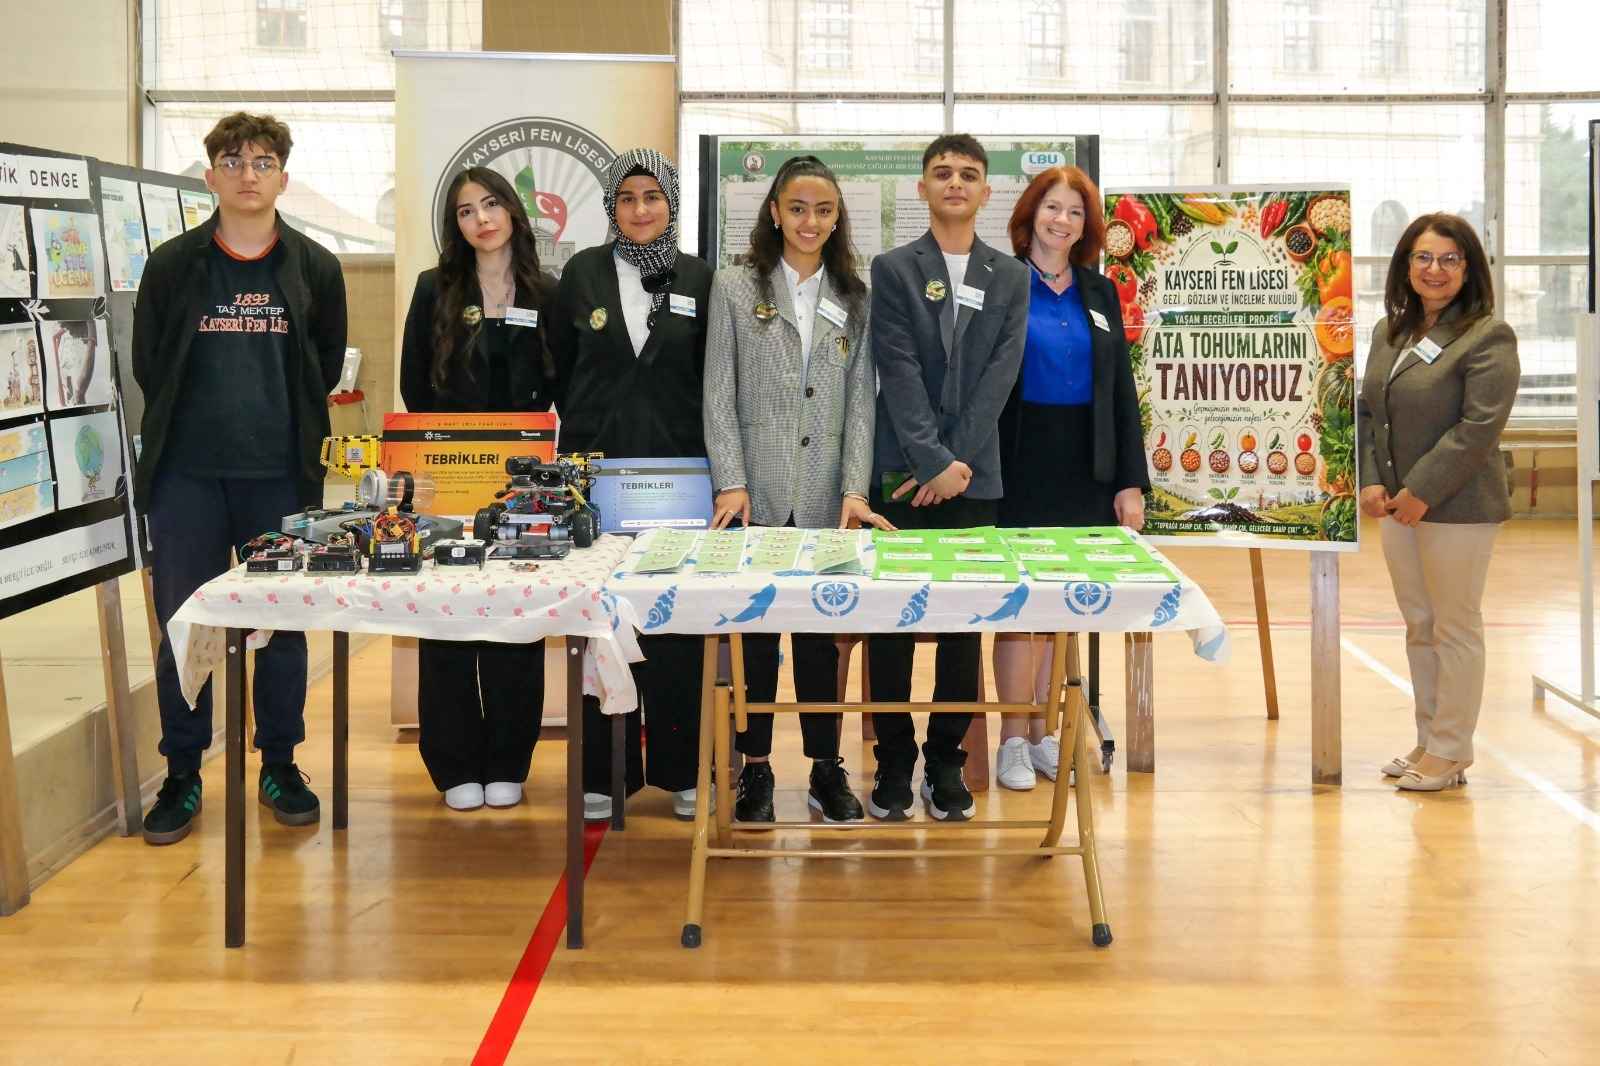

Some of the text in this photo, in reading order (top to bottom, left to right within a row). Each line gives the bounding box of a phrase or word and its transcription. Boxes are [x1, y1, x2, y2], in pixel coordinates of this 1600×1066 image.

[462, 127, 612, 173] KAYSERİ FEN LİSESİ
[30, 170, 79, 188] DENGE
[1165, 266, 1288, 290] KAYSERİ FEN LİSESİ
[233, 293, 270, 306] 1893
[1187, 291, 1218, 305] GÖZLEM
[1220, 294, 1229, 305] VE
[1231, 291, 1266, 305] İNCELEME
[1268, 292, 1297, 305] KULÜBÜ
[216, 305, 284, 316] TAŞ MEKTEP
[1175, 314, 1200, 326] YAŞAM
[1203, 312, 1247, 325] BECERİLERİ
[1152, 332, 1307, 359] ATA TOHUMLARINI
[1156, 363, 1303, 401] TANIYORUZ
[424, 452, 500, 465] TEBRİKLER!
